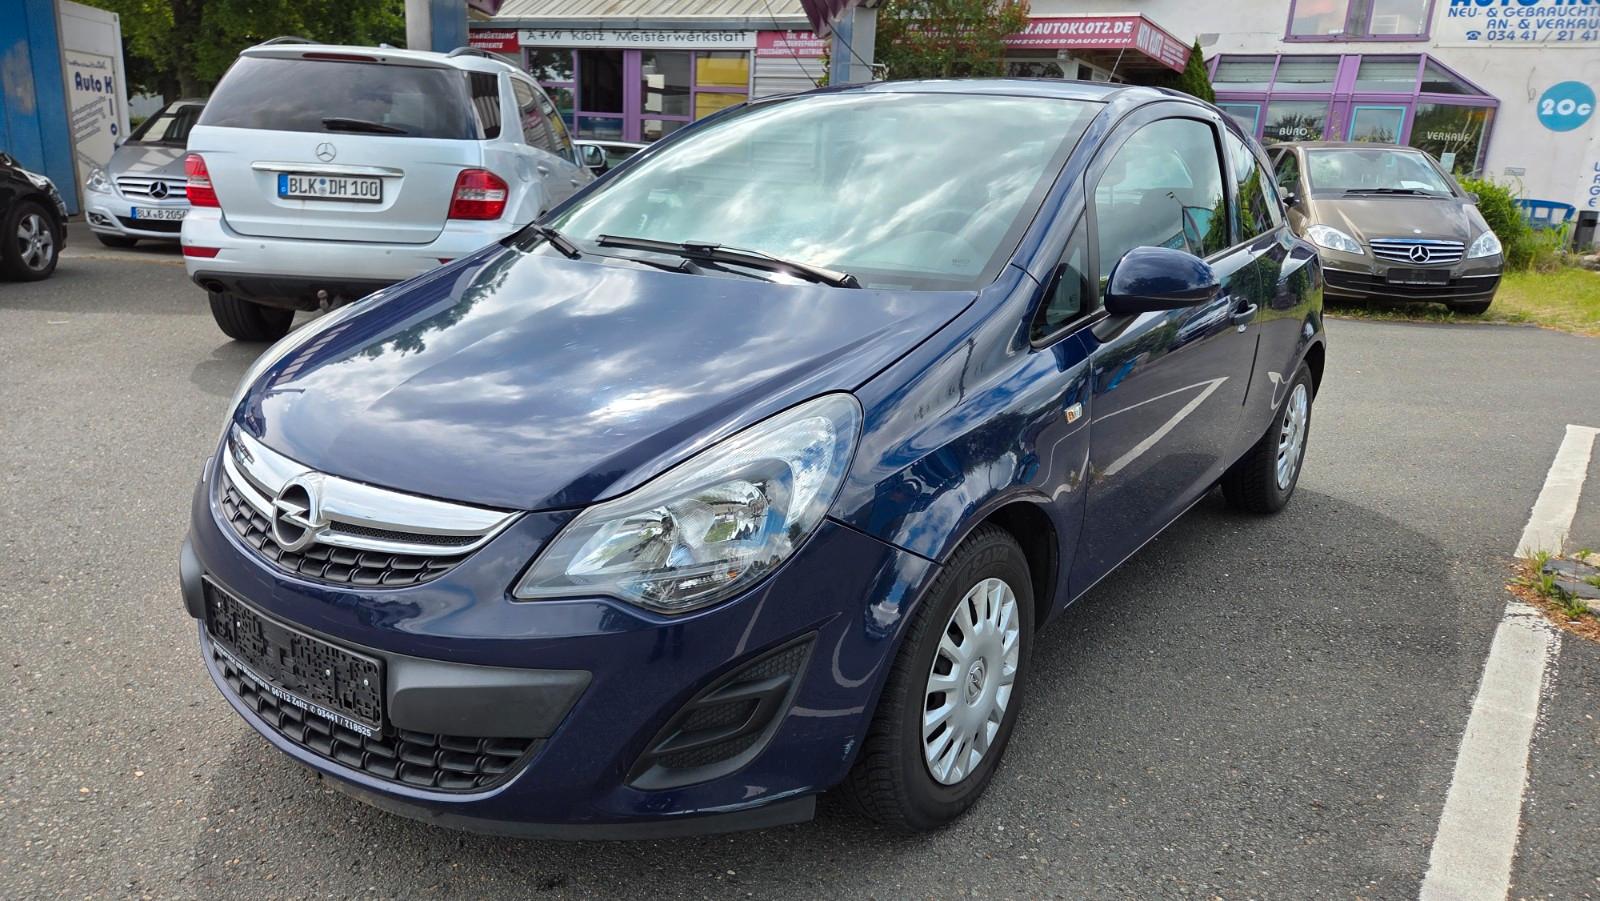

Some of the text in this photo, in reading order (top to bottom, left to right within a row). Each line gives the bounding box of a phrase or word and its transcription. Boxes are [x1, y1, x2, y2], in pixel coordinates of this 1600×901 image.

[1448, 7, 1482, 17] NEU-
[1486, 7, 1498, 18] &
[1486, 18, 1600, 29] AN- & VERKAU
[571, 30, 605, 41] Klotz
[615, 30, 747, 42] Meisterwerkstatt
[1487, 30, 1516, 41] 034
[1520, 30, 1538, 41] 41
[1558, 30, 1574, 41] 21
[1581, 30, 1598, 41] 41
[75, 71, 102, 92] Auto
[1541, 98, 1592, 116] 20c
[1427, 131, 1471, 142] VERKAUF
[289, 177, 318, 194] BLK
[328, 179, 348, 195] DH
[351, 180, 378, 196] 100
[137, 208, 153, 219] BLK
[271, 687, 291, 702] 06712
[316, 708, 338, 723] 03441
[344, 719, 372, 736] 218525
